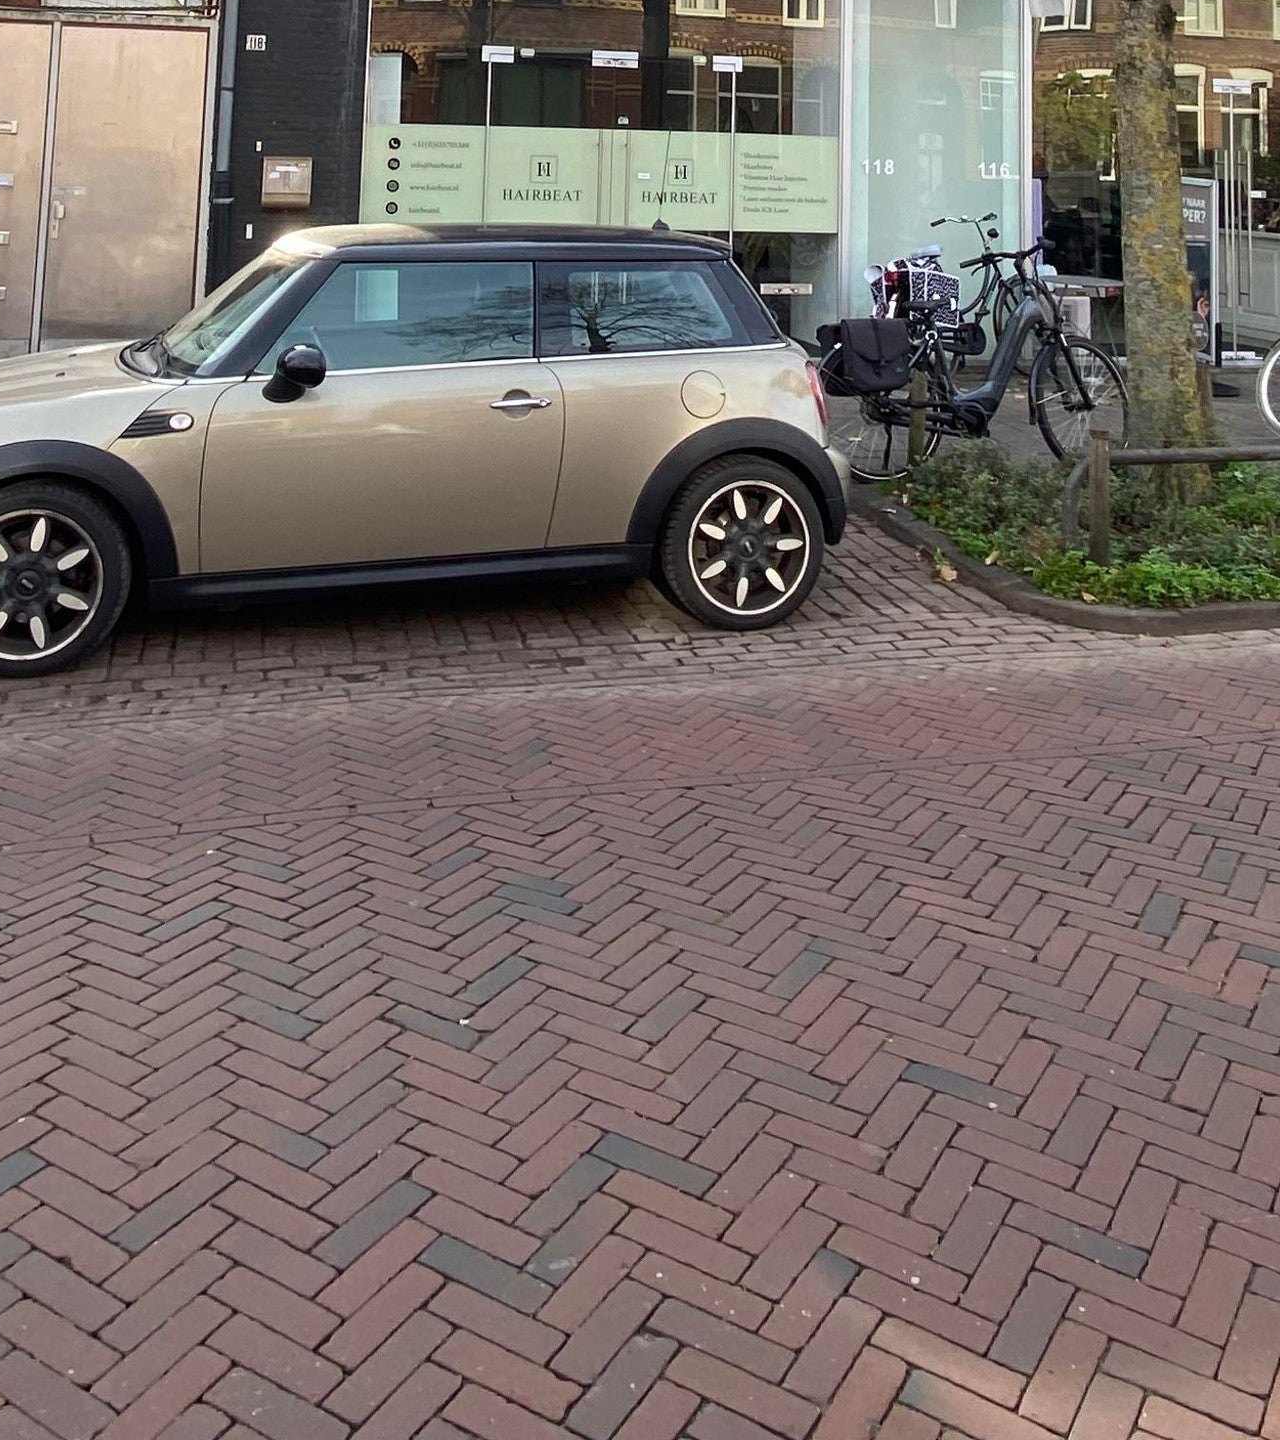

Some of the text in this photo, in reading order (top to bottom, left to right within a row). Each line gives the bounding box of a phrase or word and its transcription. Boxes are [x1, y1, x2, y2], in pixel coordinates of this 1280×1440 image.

[862, 158, 895, 175] 118
[978, 162, 1010, 178] 116
[502, 188, 583, 202] HAIRBEAT
[641, 191, 718, 205] HAIRBEAT
